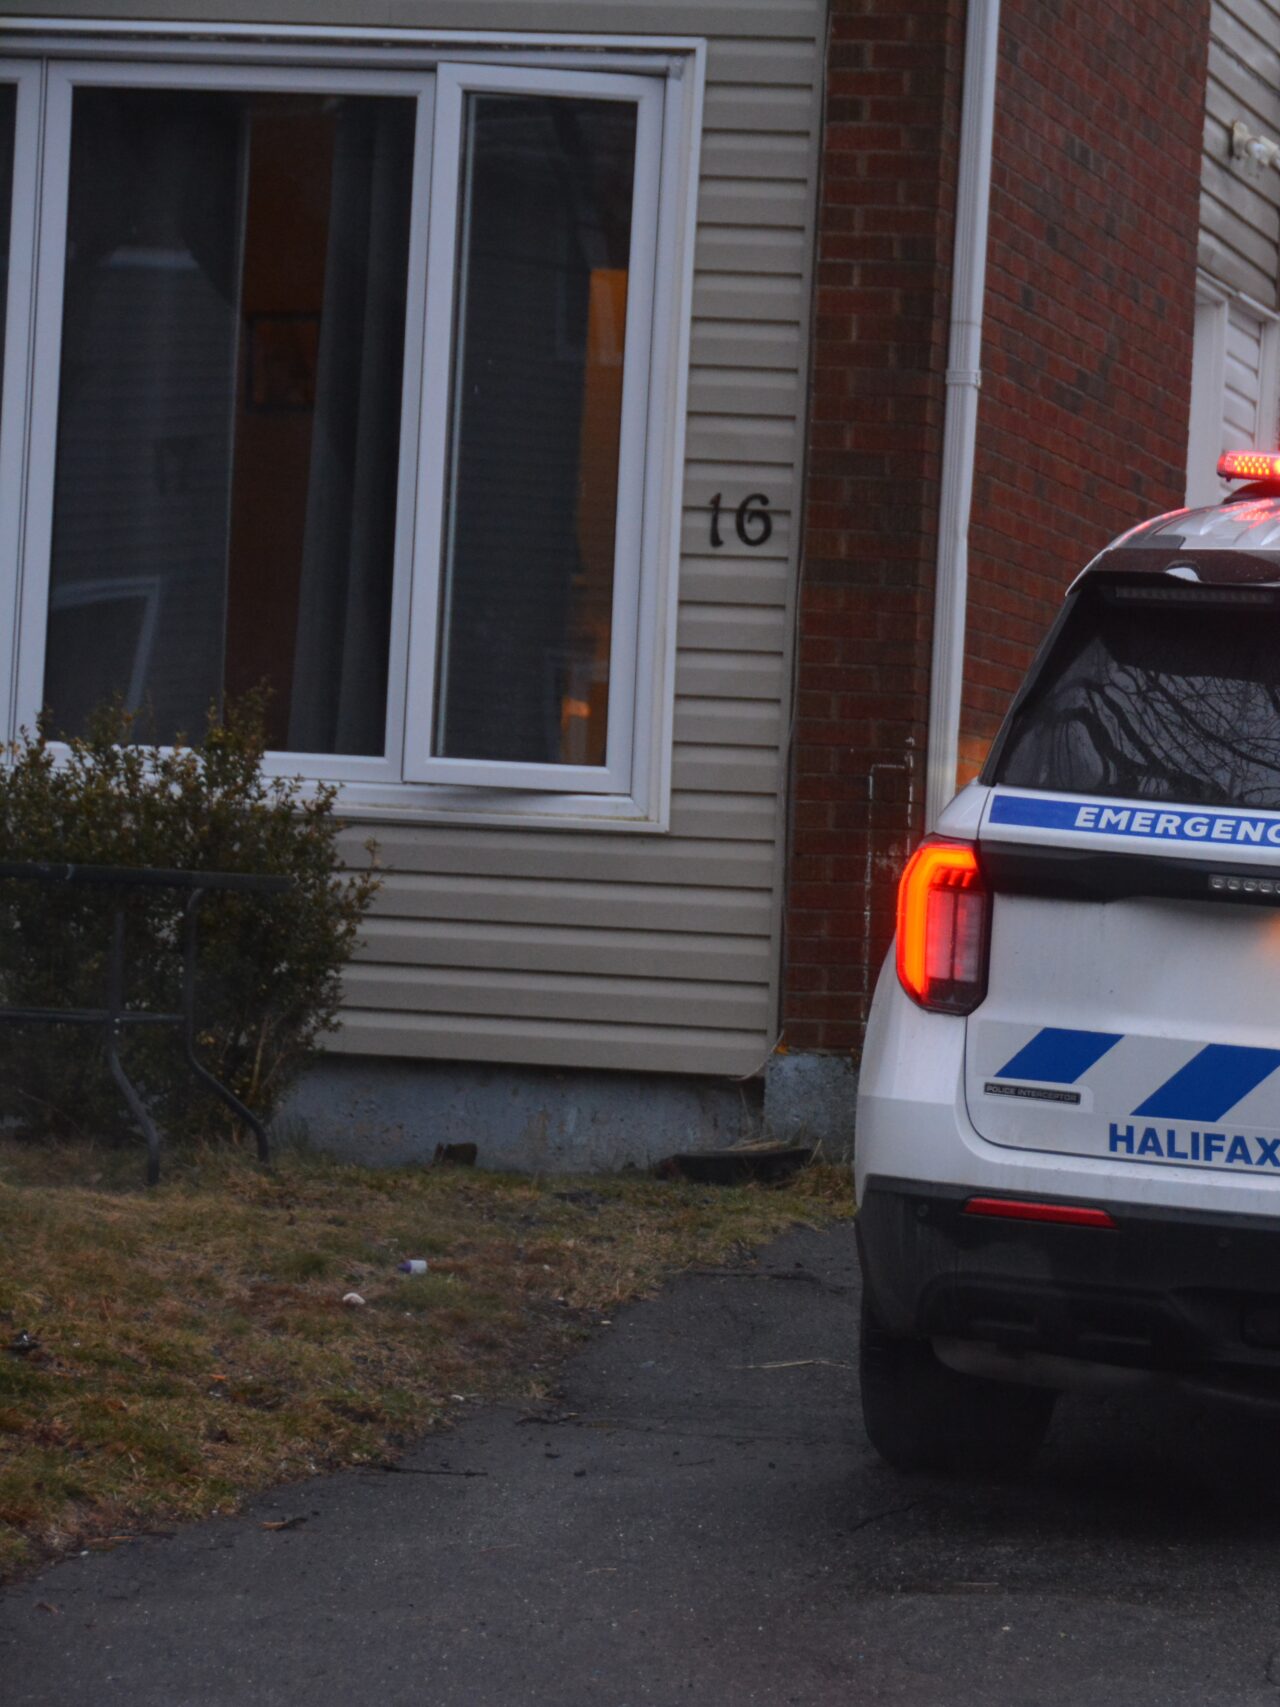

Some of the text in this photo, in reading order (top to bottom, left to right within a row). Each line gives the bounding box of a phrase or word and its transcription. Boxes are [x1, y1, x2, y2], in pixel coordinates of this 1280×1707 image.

[709, 492, 772, 548] 16
[986, 1084, 1078, 1101] POLICE INTERCEPTOR
